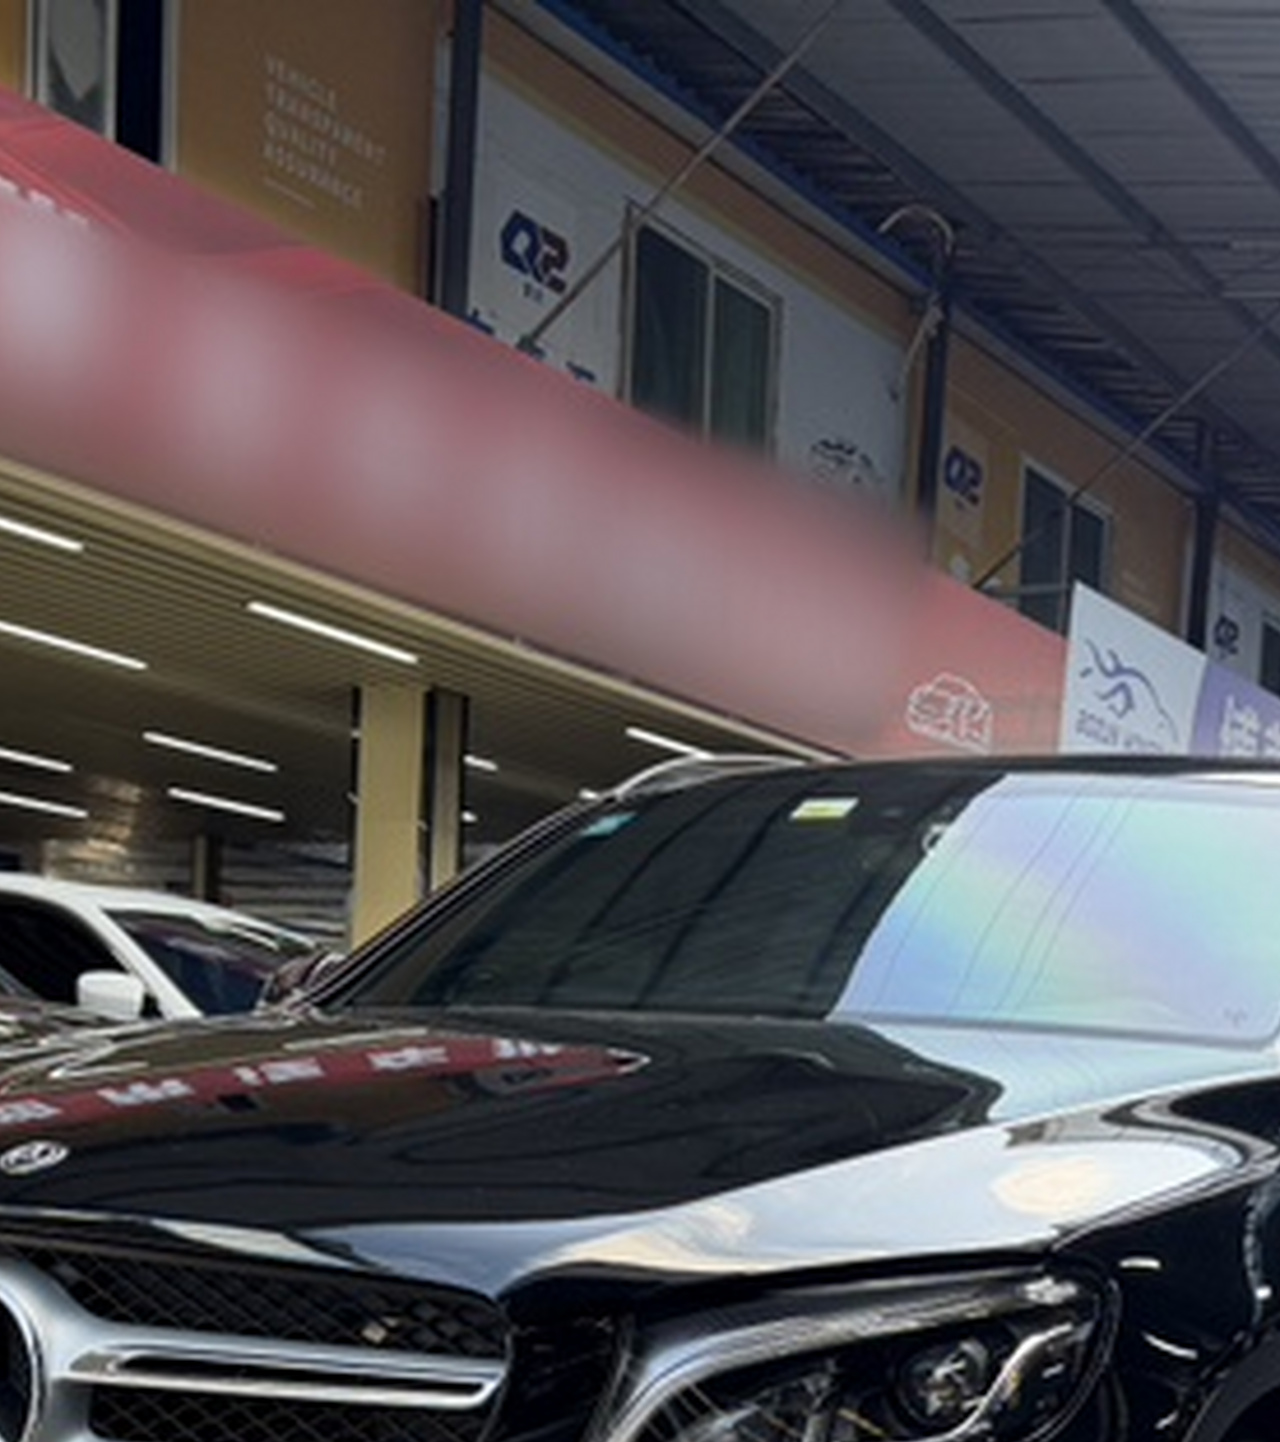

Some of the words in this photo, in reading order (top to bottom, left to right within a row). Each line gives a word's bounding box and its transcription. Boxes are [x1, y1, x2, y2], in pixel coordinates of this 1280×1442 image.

[264, 53, 336, 114] VEHICLE
[263, 110, 336, 167] QUALITY
[263, 142, 364, 211] ASSURANCE
